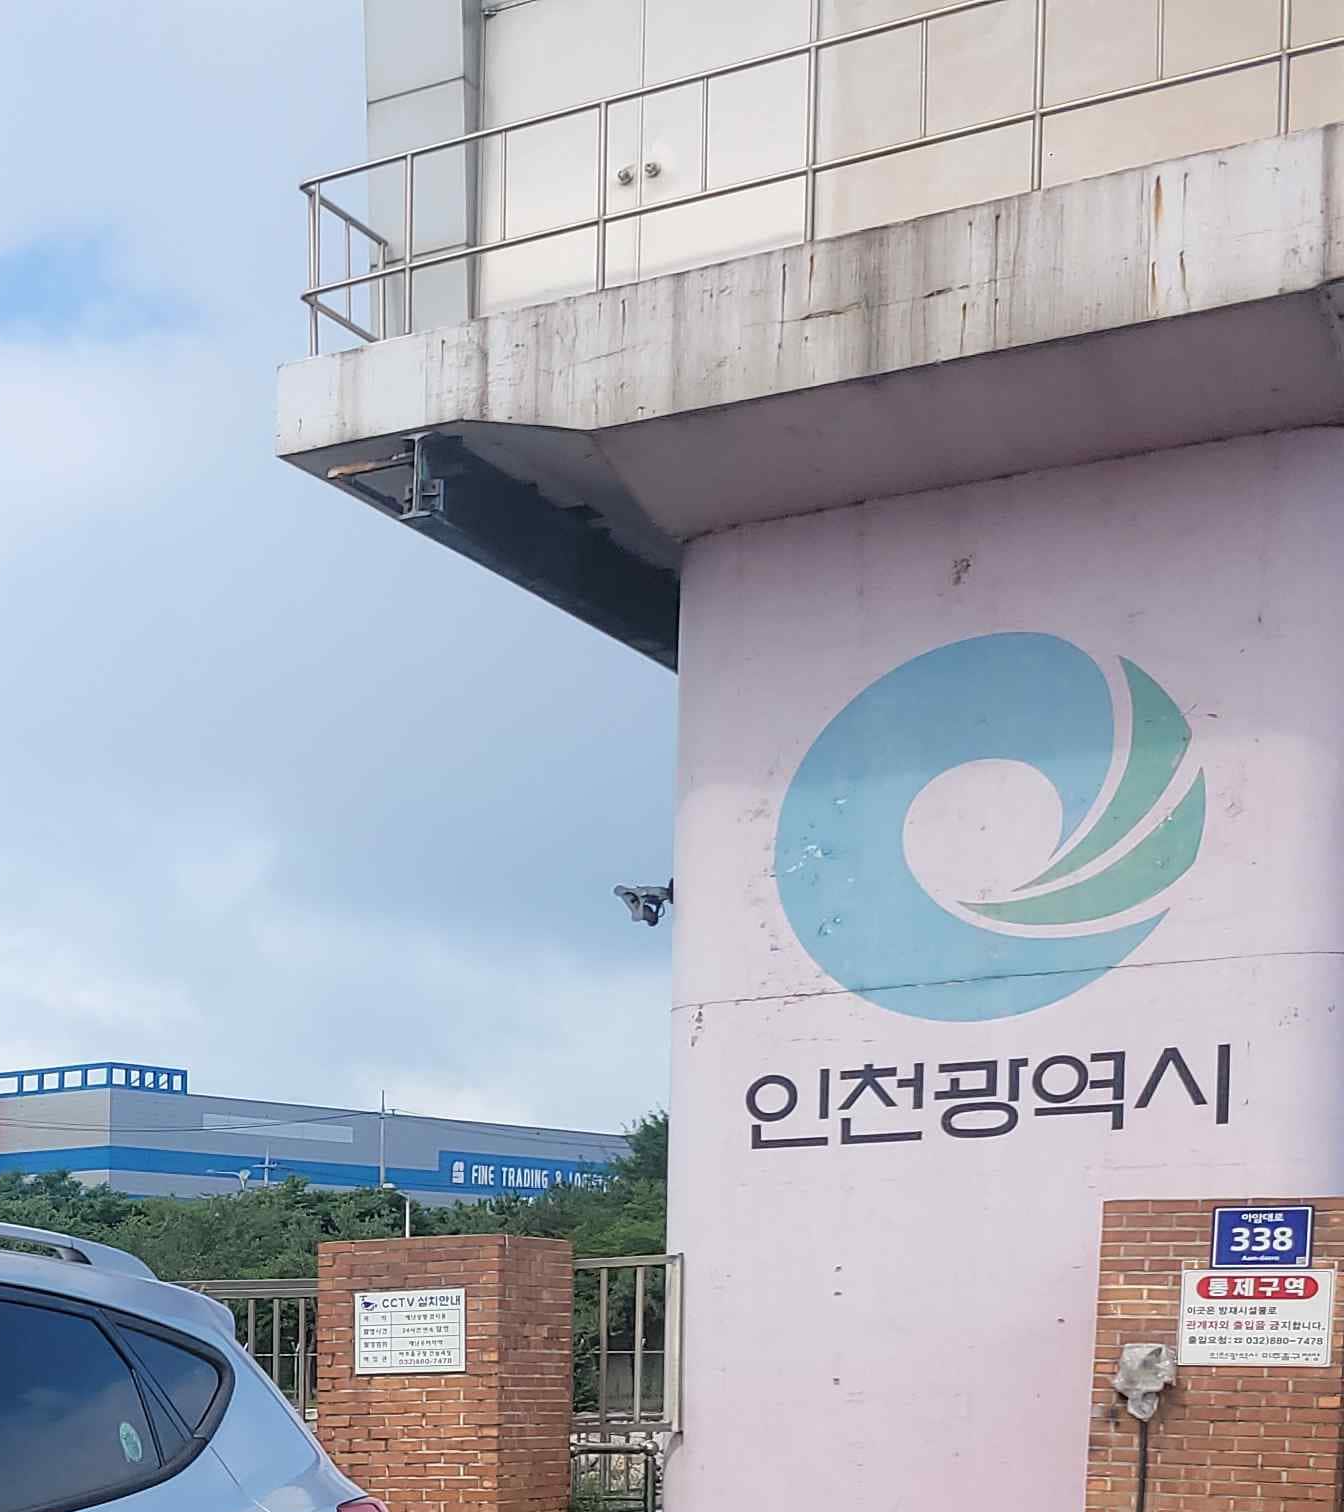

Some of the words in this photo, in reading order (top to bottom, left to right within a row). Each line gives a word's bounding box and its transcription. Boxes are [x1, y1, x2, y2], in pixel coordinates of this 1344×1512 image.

[744, 1043, 1232, 1150] 인천광역시
[471, 1164, 495, 1186] FINE
[502, 1167, 549, 1189] TRADING
[1230, 1227, 1293, 1252] 338
[1207, 1276, 1306, 1297] 통제구역
[382, 1297, 415, 1309] CCTV
[417, 1295, 461, 1308] 설치안내
[1269, 1320, 1327, 1331] 금지합니다.
